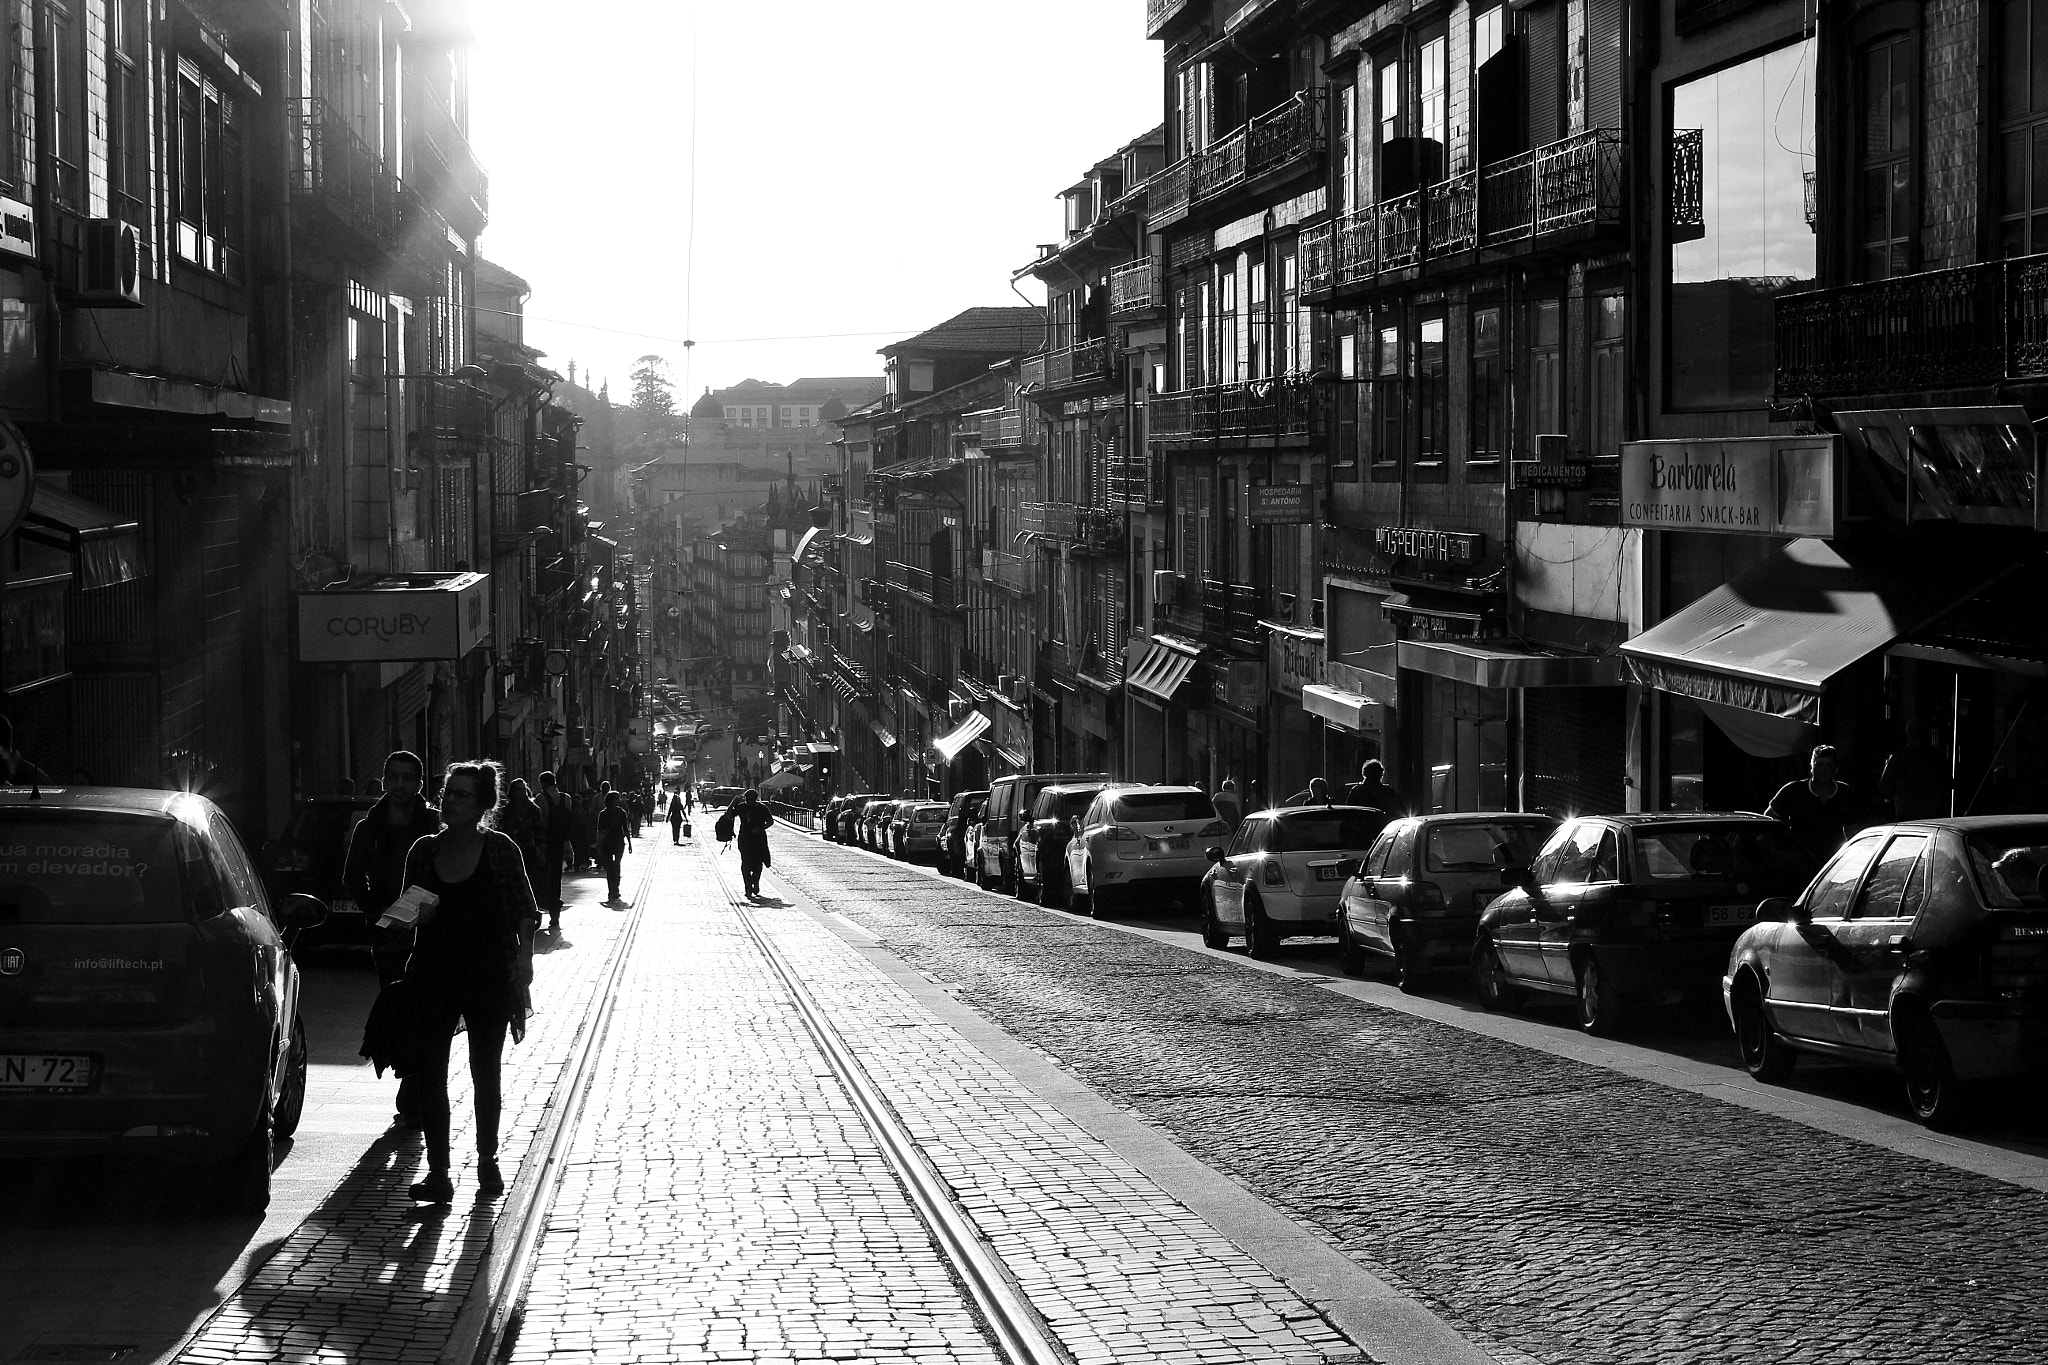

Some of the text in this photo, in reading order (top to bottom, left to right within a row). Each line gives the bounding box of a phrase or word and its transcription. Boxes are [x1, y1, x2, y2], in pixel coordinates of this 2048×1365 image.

[1520, 465, 1586, 477] MEDICAMENTOS
[1650, 451, 1736, 492] Barbarela
[1259, 487, 1302, 496] HOSPEDARIA
[1629, 503, 1760, 526] CONFEITARIA SNACK-BAR
[1376, 527, 1448, 561] HOSPEDARIA
[327, 613, 431, 642] CORUBY
[36, 843, 130, 859] moradia
[27, 860, 148, 878] elevador?
[334, 901, 348, 911] 66
[1711, 907, 1728, 920] 56
[3, 956, 20, 968] FIAT
[74, 958, 164, 972] info@liftech.pt
